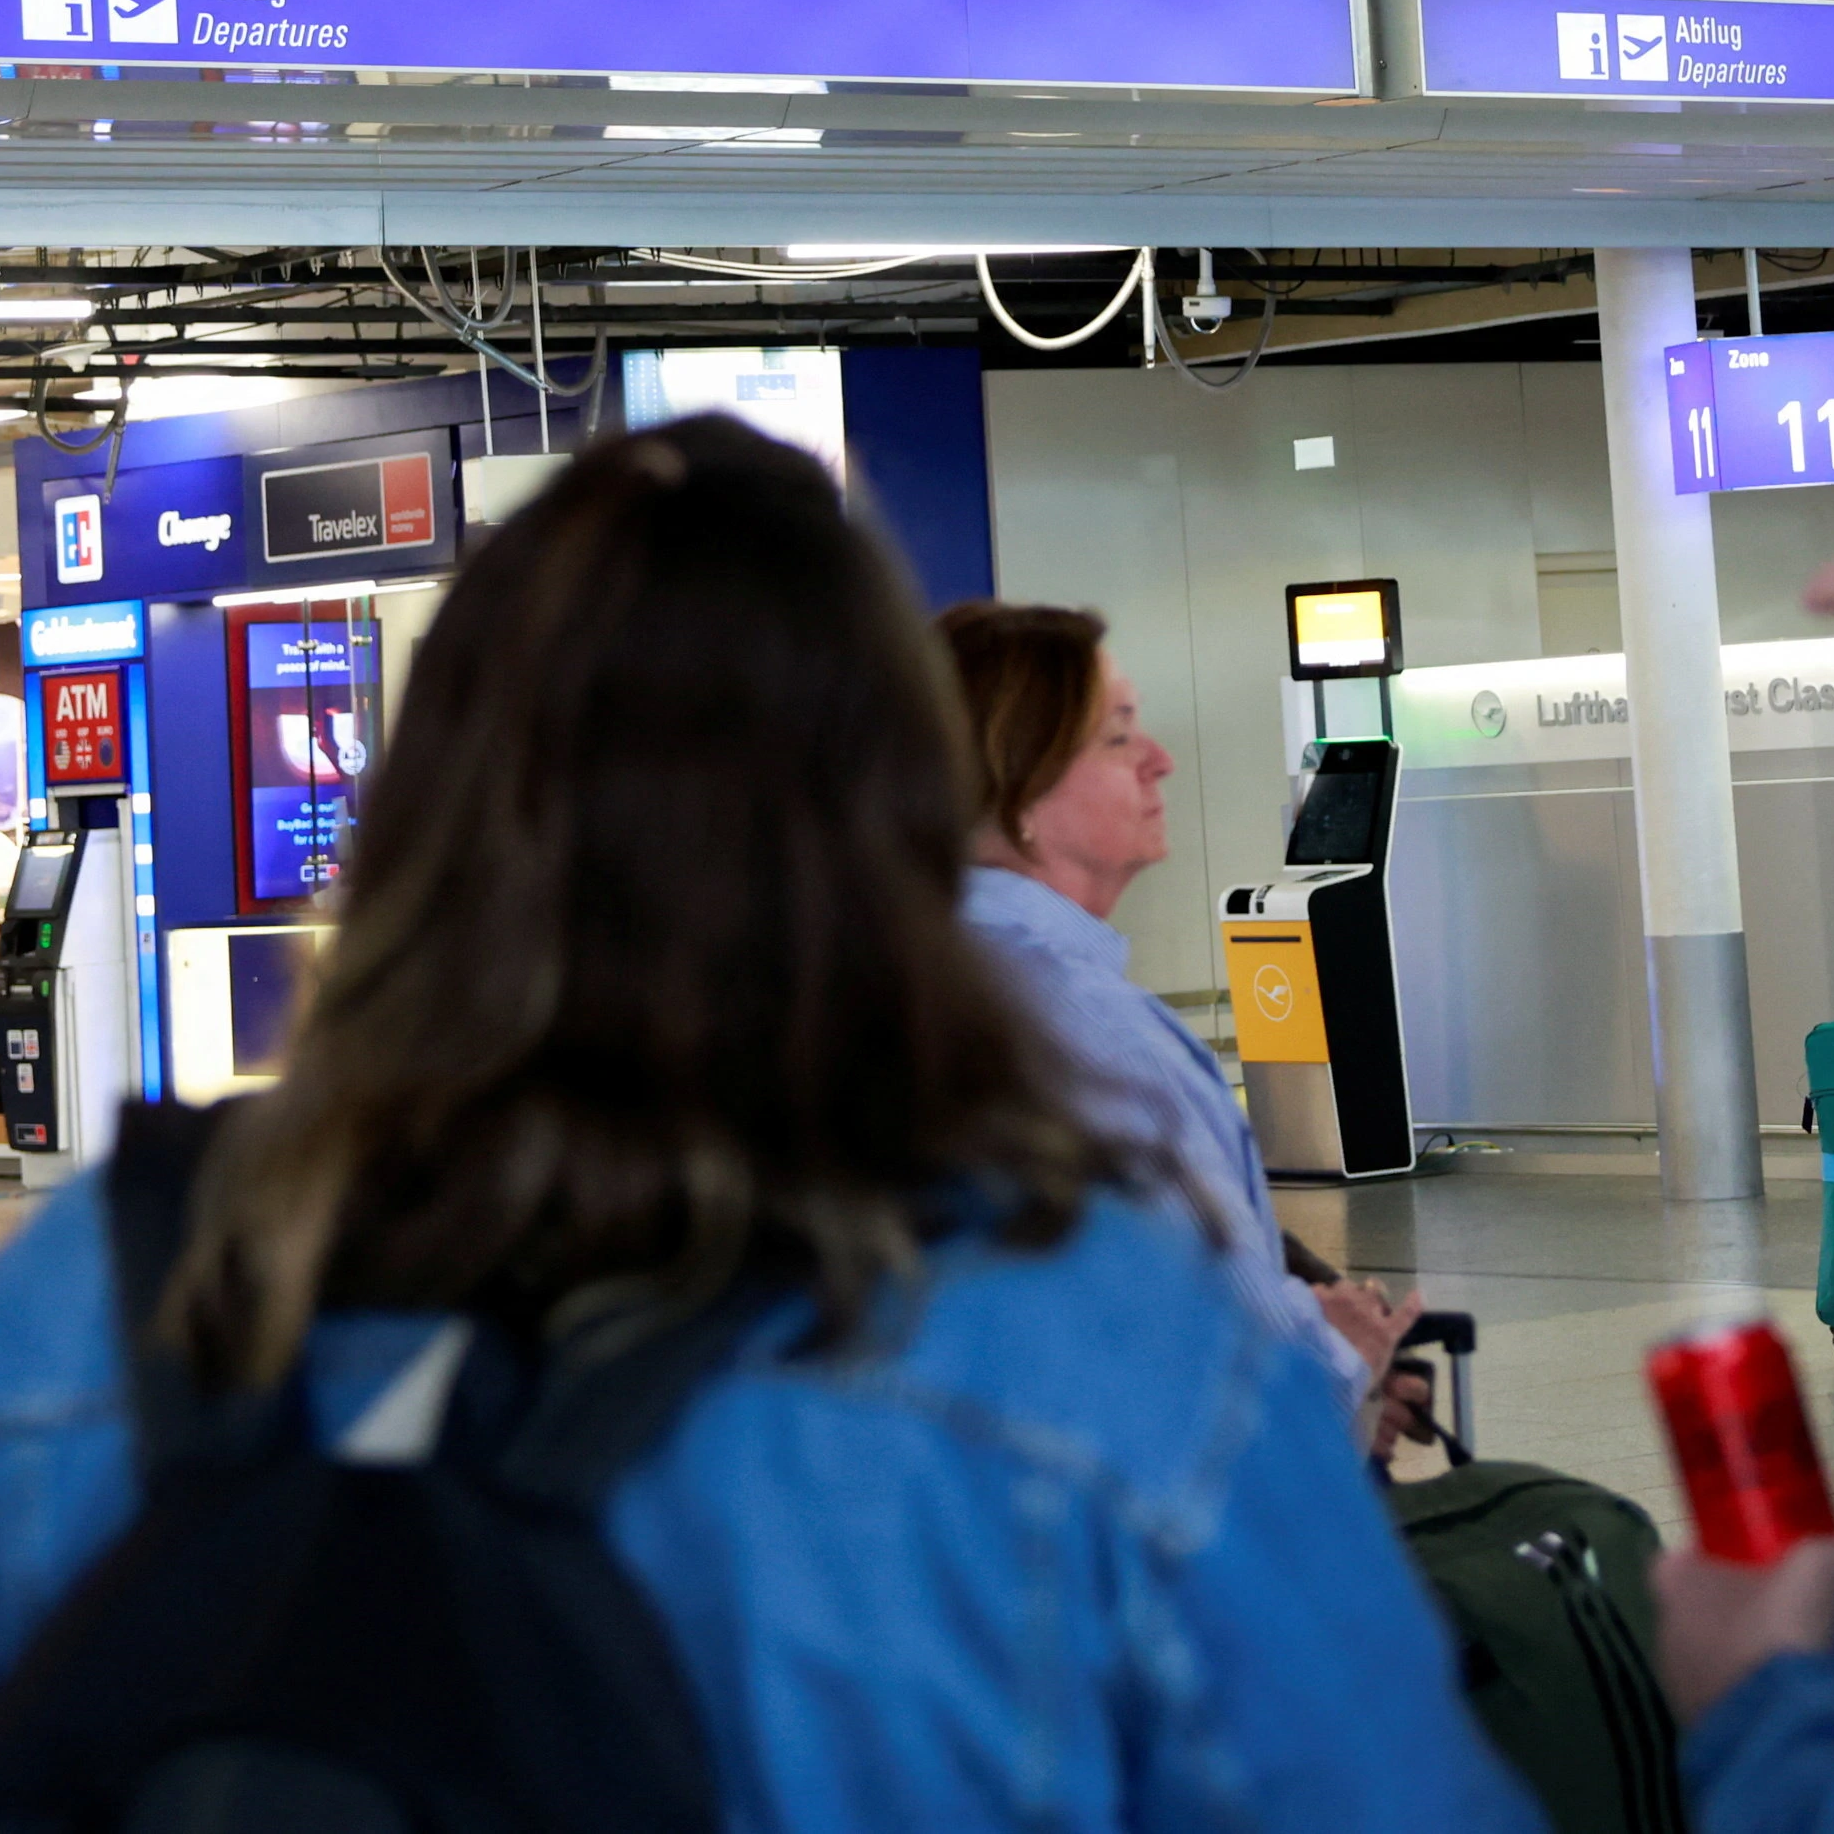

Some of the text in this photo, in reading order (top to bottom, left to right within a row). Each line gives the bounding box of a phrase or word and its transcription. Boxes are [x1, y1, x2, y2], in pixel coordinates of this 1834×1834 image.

[193, 13, 349, 53] Departures
[1676, 16, 1742, 49] Abflug
[1678, 54, 1787, 86] Departures
[1728, 349, 1769, 369] Zone
[1688, 407, 1715, 478] 11
[158, 511, 232, 552] Change
[308, 509, 378, 543] Travelex
[56, 683, 108, 722] ATM
